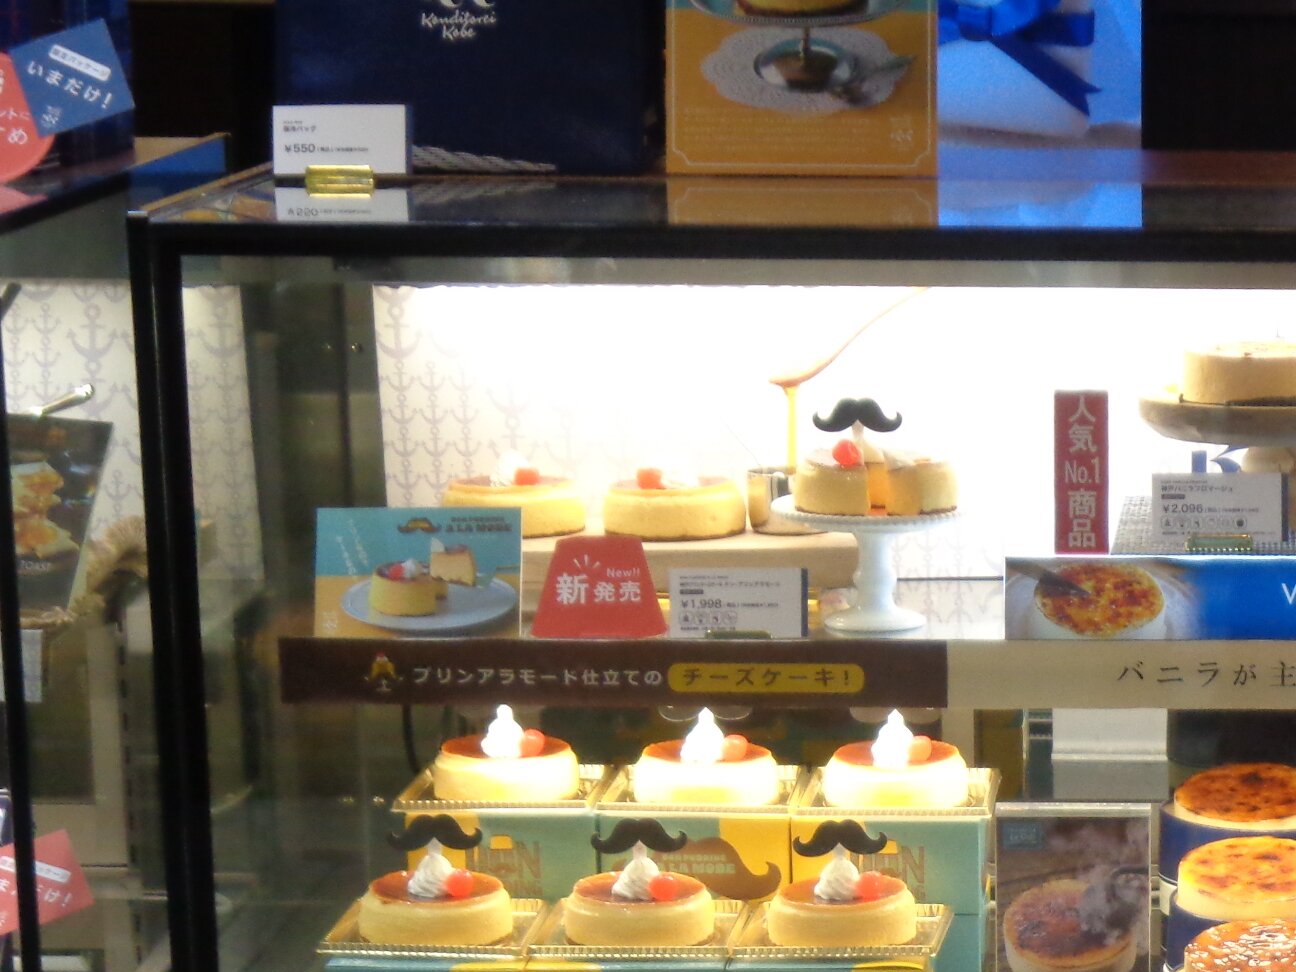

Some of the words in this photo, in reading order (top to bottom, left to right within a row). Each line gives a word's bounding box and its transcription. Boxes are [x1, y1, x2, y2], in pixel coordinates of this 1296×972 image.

[442, 25, 477, 40] Kobe
[556, 573, 641, 605] 新発売
[413, 667, 662, 686] プリンアラモード仕立ての
[684, 668, 849, 686] チーズケーキ!
